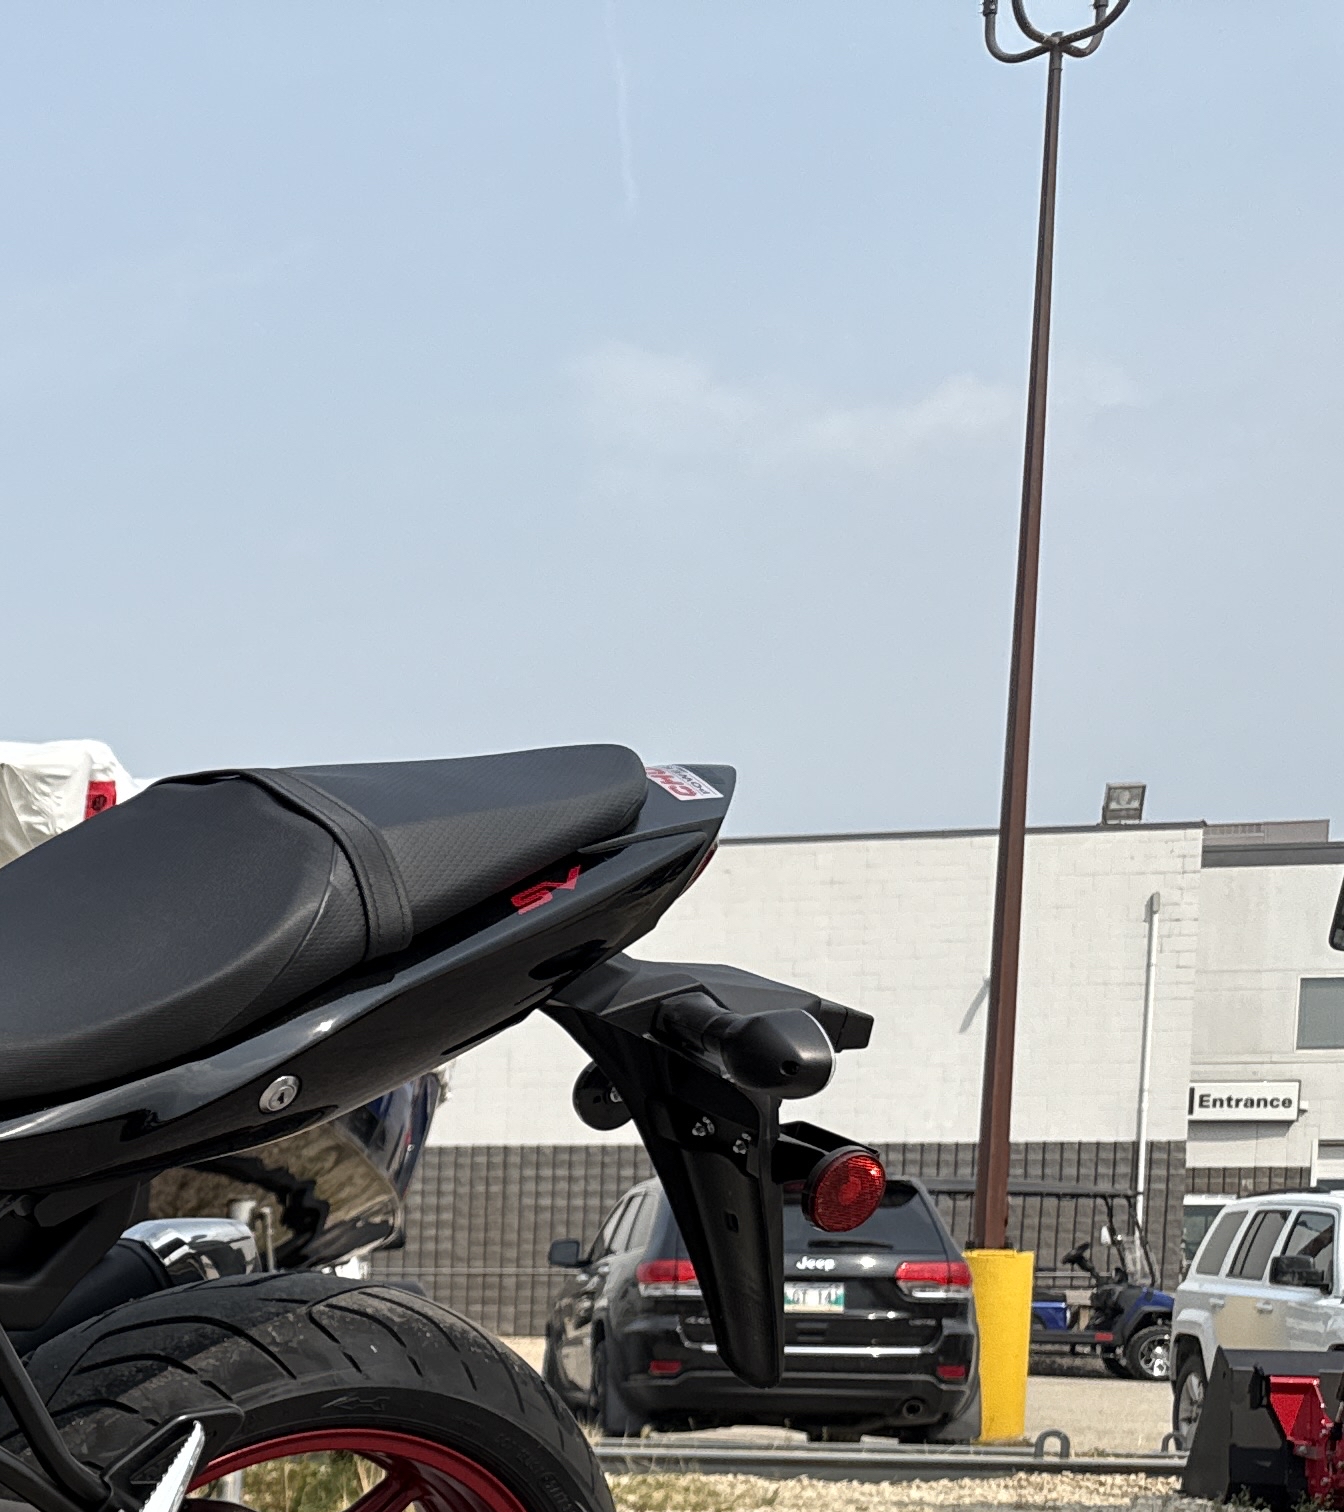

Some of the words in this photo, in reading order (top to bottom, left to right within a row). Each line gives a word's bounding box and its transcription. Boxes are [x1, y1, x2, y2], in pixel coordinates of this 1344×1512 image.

[511, 864, 581, 915] SV
[1197, 1093, 1294, 1109] Entrance
[796, 1255, 836, 1272] Jeep
